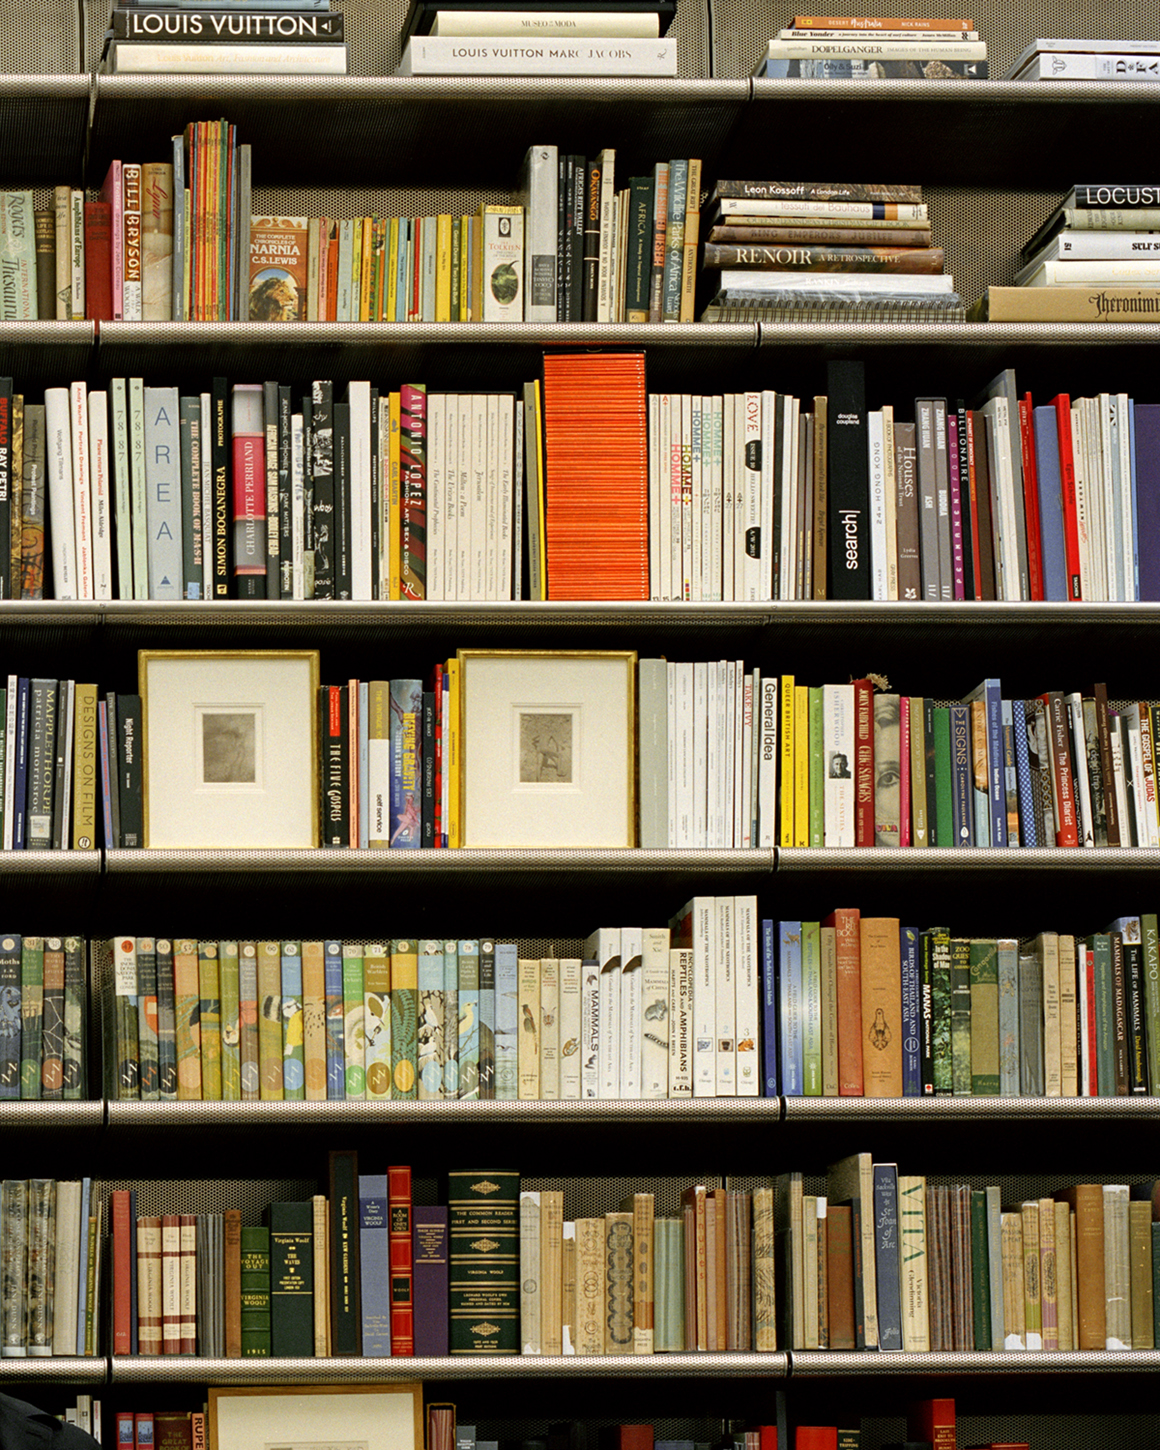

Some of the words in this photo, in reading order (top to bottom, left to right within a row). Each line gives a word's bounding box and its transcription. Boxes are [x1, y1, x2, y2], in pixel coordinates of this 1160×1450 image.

[134, 14, 203, 34] LOUIS
[210, 15, 317, 36] VUITTON
[452, 48, 487, 57] LOUIS
[493, 48, 543, 58] VUITTON
[549, 49, 581, 58] MARC
[587, 49, 632, 59] JACOBS
[126, 169, 139, 208] BILL
[590, 170, 601, 221] OKAVANGO
[672, 180, 685, 220] Wildlife
[745, 185, 767, 194] Leon
[769, 186, 804, 195] Kossoff
[637, 202, 647, 236] AFRICA
[670, 221, 682, 249] Parks
[127, 216, 140, 279] BRYSON
[250, 244, 300, 255] NARNIA
[670, 251, 680, 262] of
[736, 249, 812, 265] RENOIR
[827, 254, 901, 263] RETROSPECTIVE
[668, 263, 680, 292] Africa
[410, 395, 422, 455] ANTONIO
[936, 409, 945, 430] ZHANG
[958, 408, 968, 482] BILLIONAIRE
[244, 442, 254, 493] PERRIAND
[410, 465, 422, 506] LOPEZ
[903, 446, 916, 497] Houses
[216, 466, 226, 535] BOCANEGRA
[939, 489, 948, 516] BUDDHA
[246, 495, 256, 555] CHARLOTTE
[842, 514, 858, 569] search
[217, 538, 226, 576] SIMON
[763, 683, 776, 731] General
[1053, 698, 1063, 722] Carrie
[83, 696, 94, 759] DESIGNS
[1055, 725, 1065, 747] Fisher
[43, 689, 55, 814] MAPPLETHORPE
[763, 734, 775, 761] Idea
[82, 764, 93, 787] ON
[82, 792, 93, 826] FILM
[1146, 929, 1158, 980] KAKAPO
[590, 990, 599, 1051] MAMMALS
[922, 984, 931, 1019] MANAS
[901, 1183, 925, 1265] VITA
